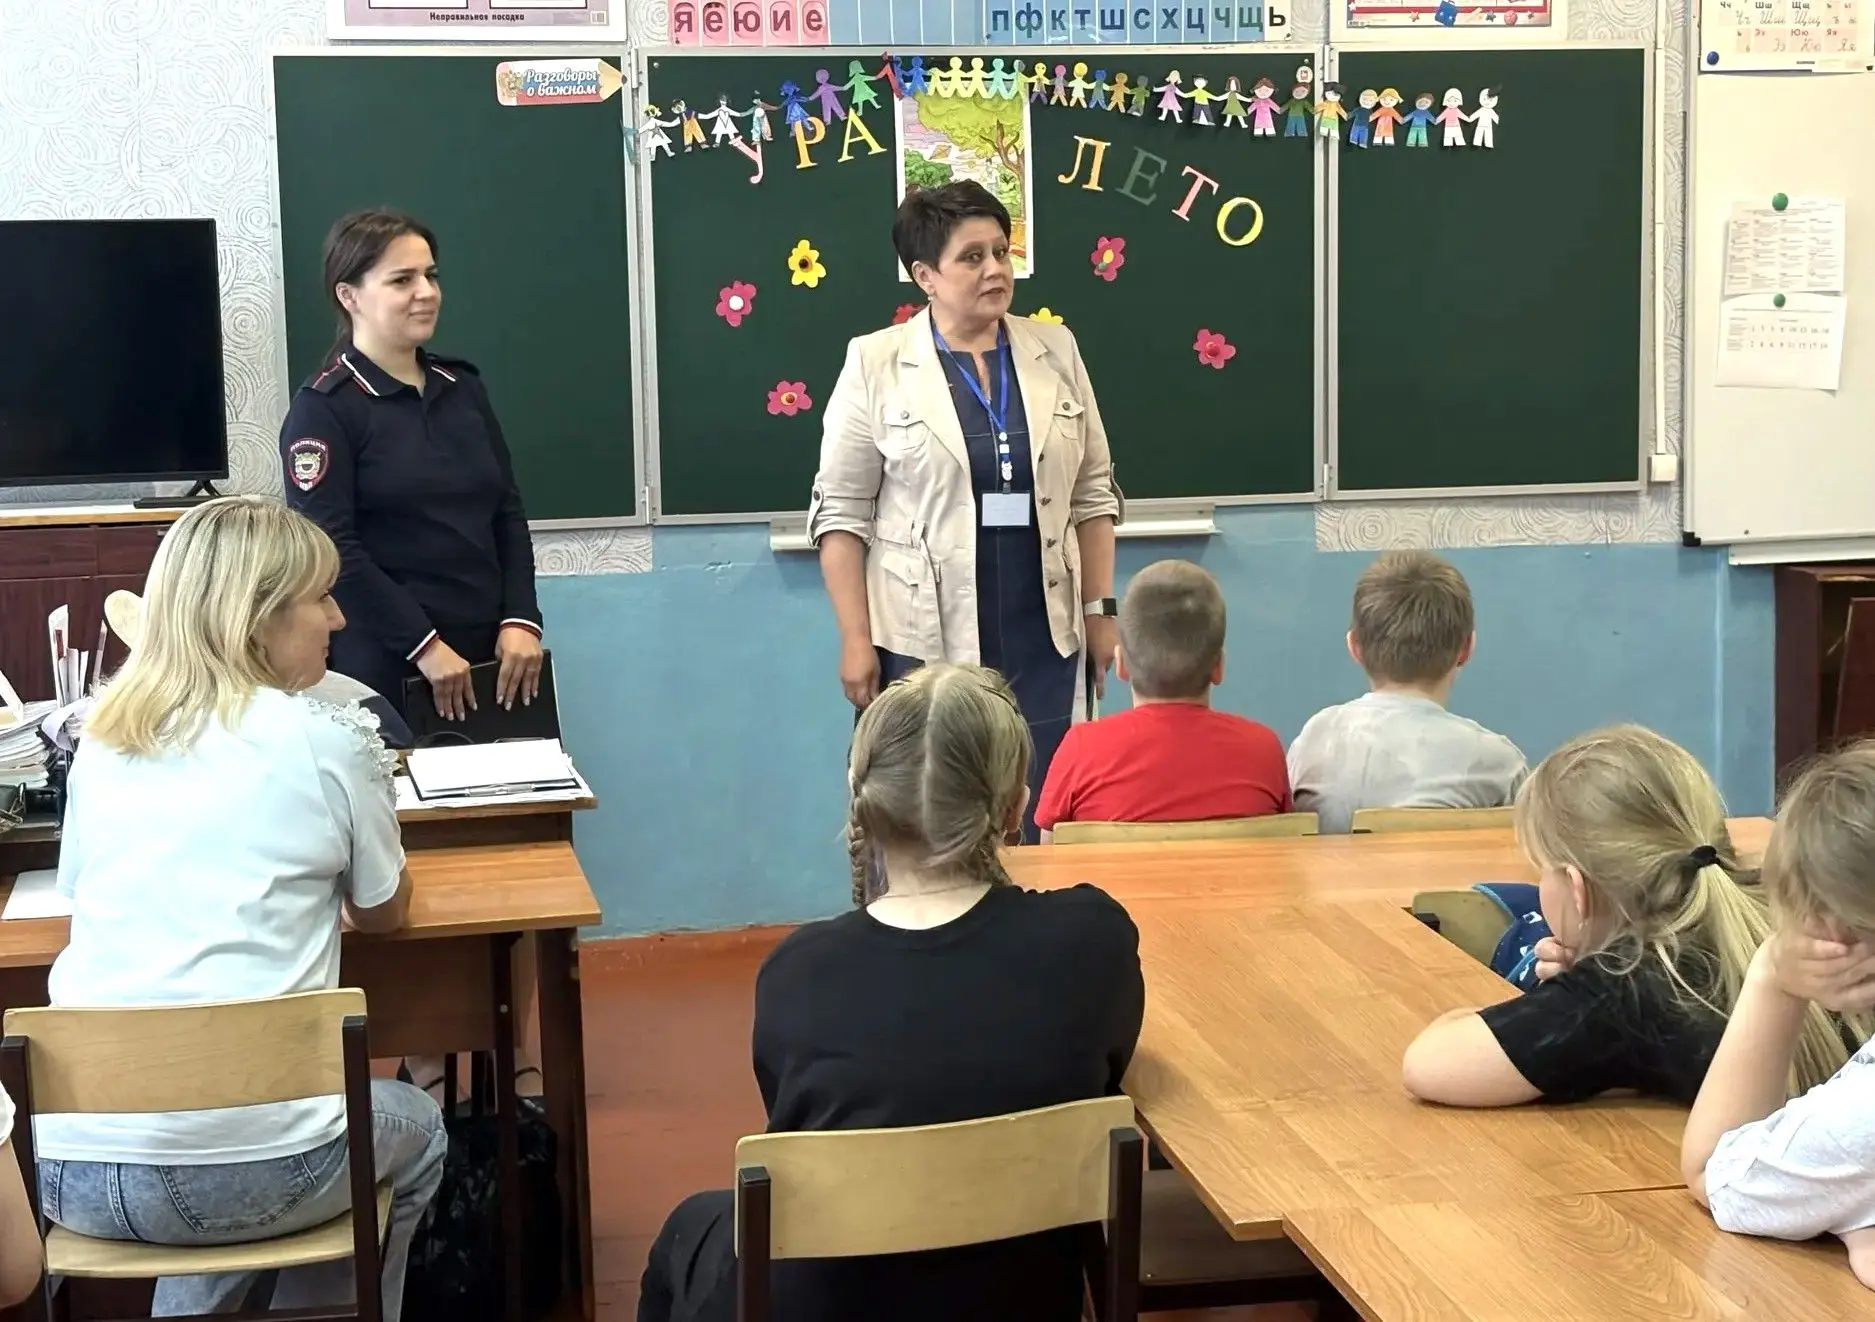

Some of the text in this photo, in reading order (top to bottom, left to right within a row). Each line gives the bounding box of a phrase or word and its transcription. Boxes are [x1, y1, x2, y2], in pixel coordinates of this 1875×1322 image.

[734, 10, 761, 33] ю
[772, 9, 791, 32] и
[806, 9, 824, 32] е
[992, 10, 1009, 31] п
[1015, 2, 1043, 38] ф
[1051, 9, 1067, 31] к
[1074, 9, 1091, 31] т
[1101, 8, 1125, 30] ш
[1187, 7, 1205, 34] ц
[1214, 7, 1230, 28] ч
[1239, 7, 1263, 33] щ
[1269, 6, 1286, 27] ь
[524, 67, 598, 86] Разговоры
[526, 82, 597, 97] о важном
[728, 106, 887, 184] УРА
[1057, 135, 1264, 246] ЛЕТО
